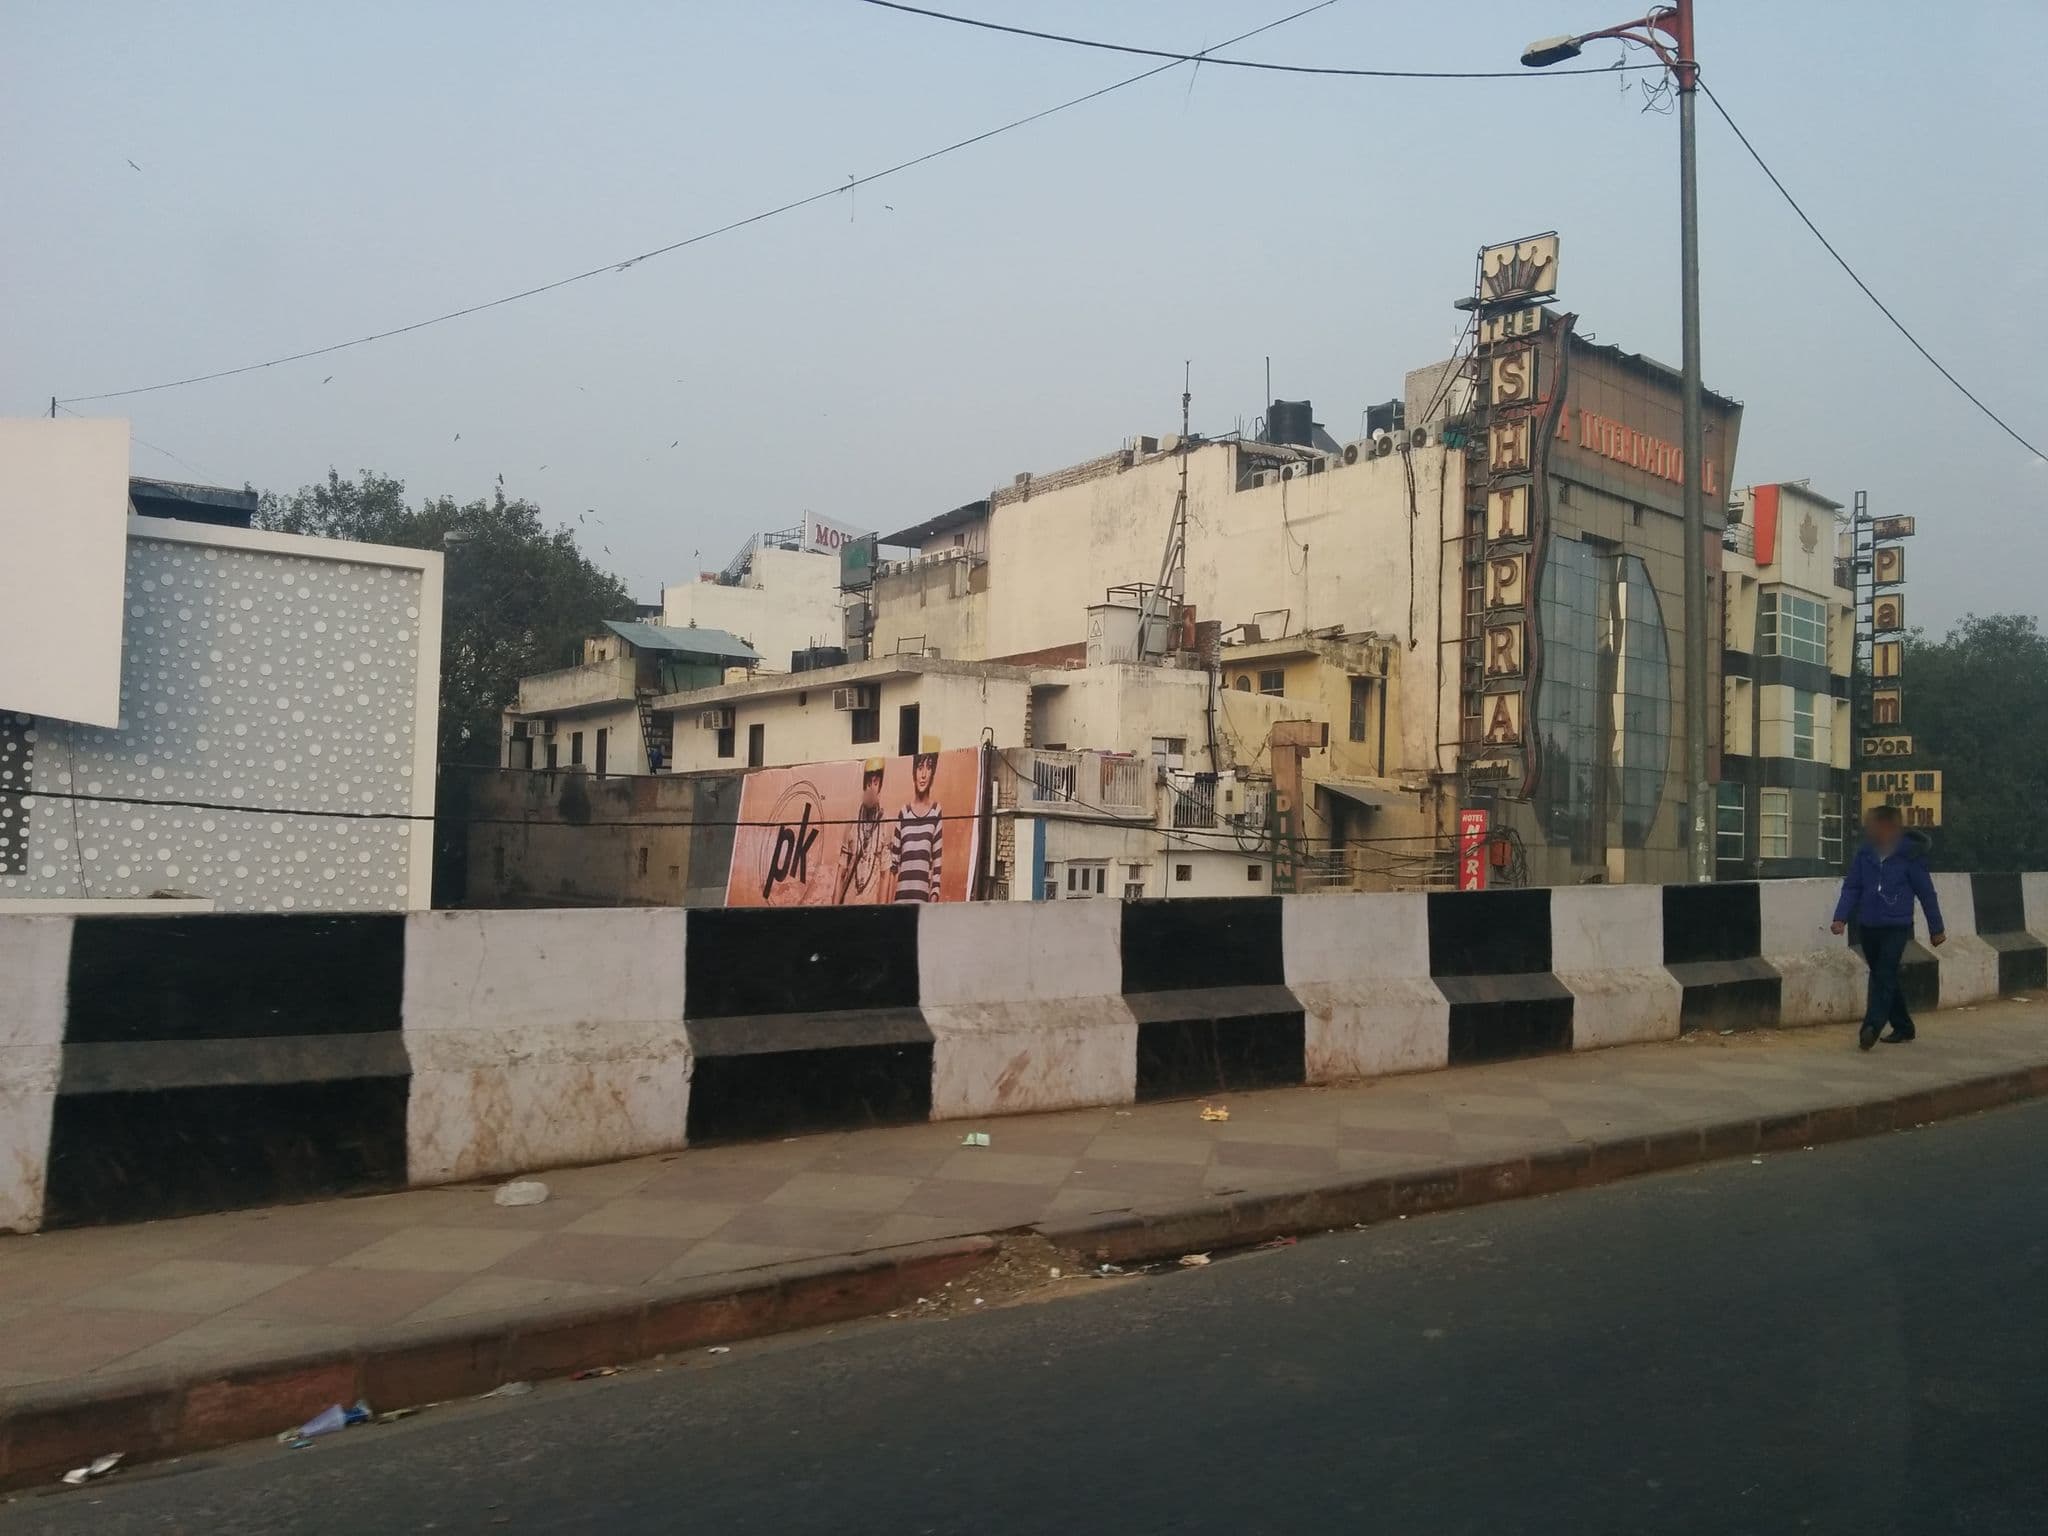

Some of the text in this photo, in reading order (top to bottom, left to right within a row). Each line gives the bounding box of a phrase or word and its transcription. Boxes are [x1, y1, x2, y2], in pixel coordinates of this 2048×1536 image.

[1487, 309, 1534, 341] THE
[1579, 408, 1717, 496] INTERNATIOL
[1485, 354, 1525, 743] SHIPRA
[1863, 739, 1909, 754] D'OR
[1867, 773, 1908, 791] MAPLE
[1462, 814, 1483, 822] HOTEL
[763, 802, 819, 899] pk
